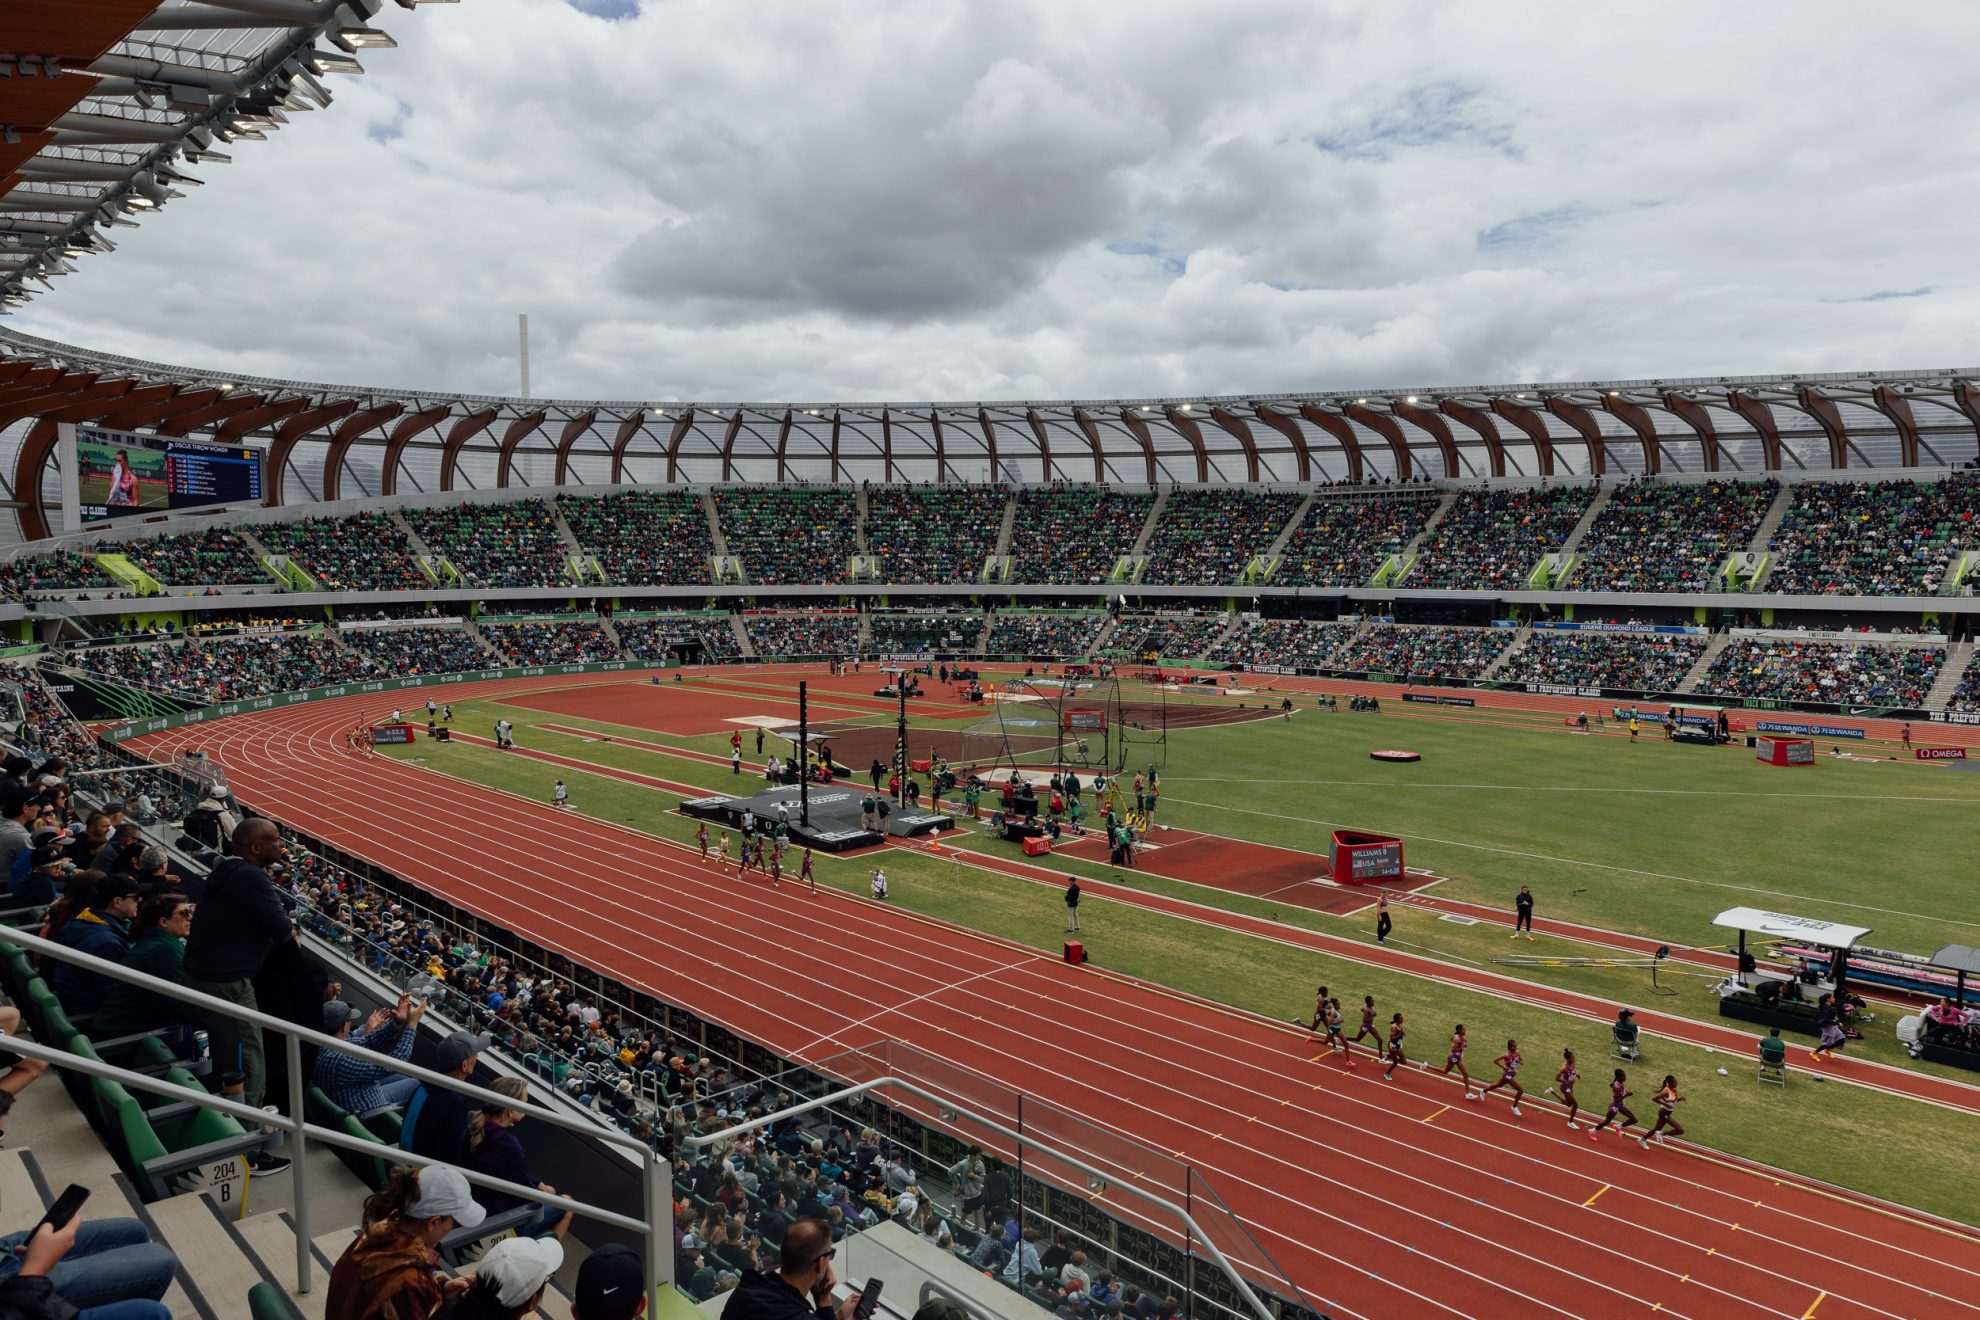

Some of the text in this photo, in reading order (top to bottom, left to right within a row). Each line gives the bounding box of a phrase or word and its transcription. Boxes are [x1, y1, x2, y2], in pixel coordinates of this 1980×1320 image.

[1539, 686, 1576, 694] PREFONTAINE
[1578, 688, 1600, 696] CLASSIC
[1930, 712, 1980, 723] THE PREFON
[1882, 950, 1903, 959] GROVE
[214, 1161, 236, 1180] 204
[221, 1183, 230, 1202] B
